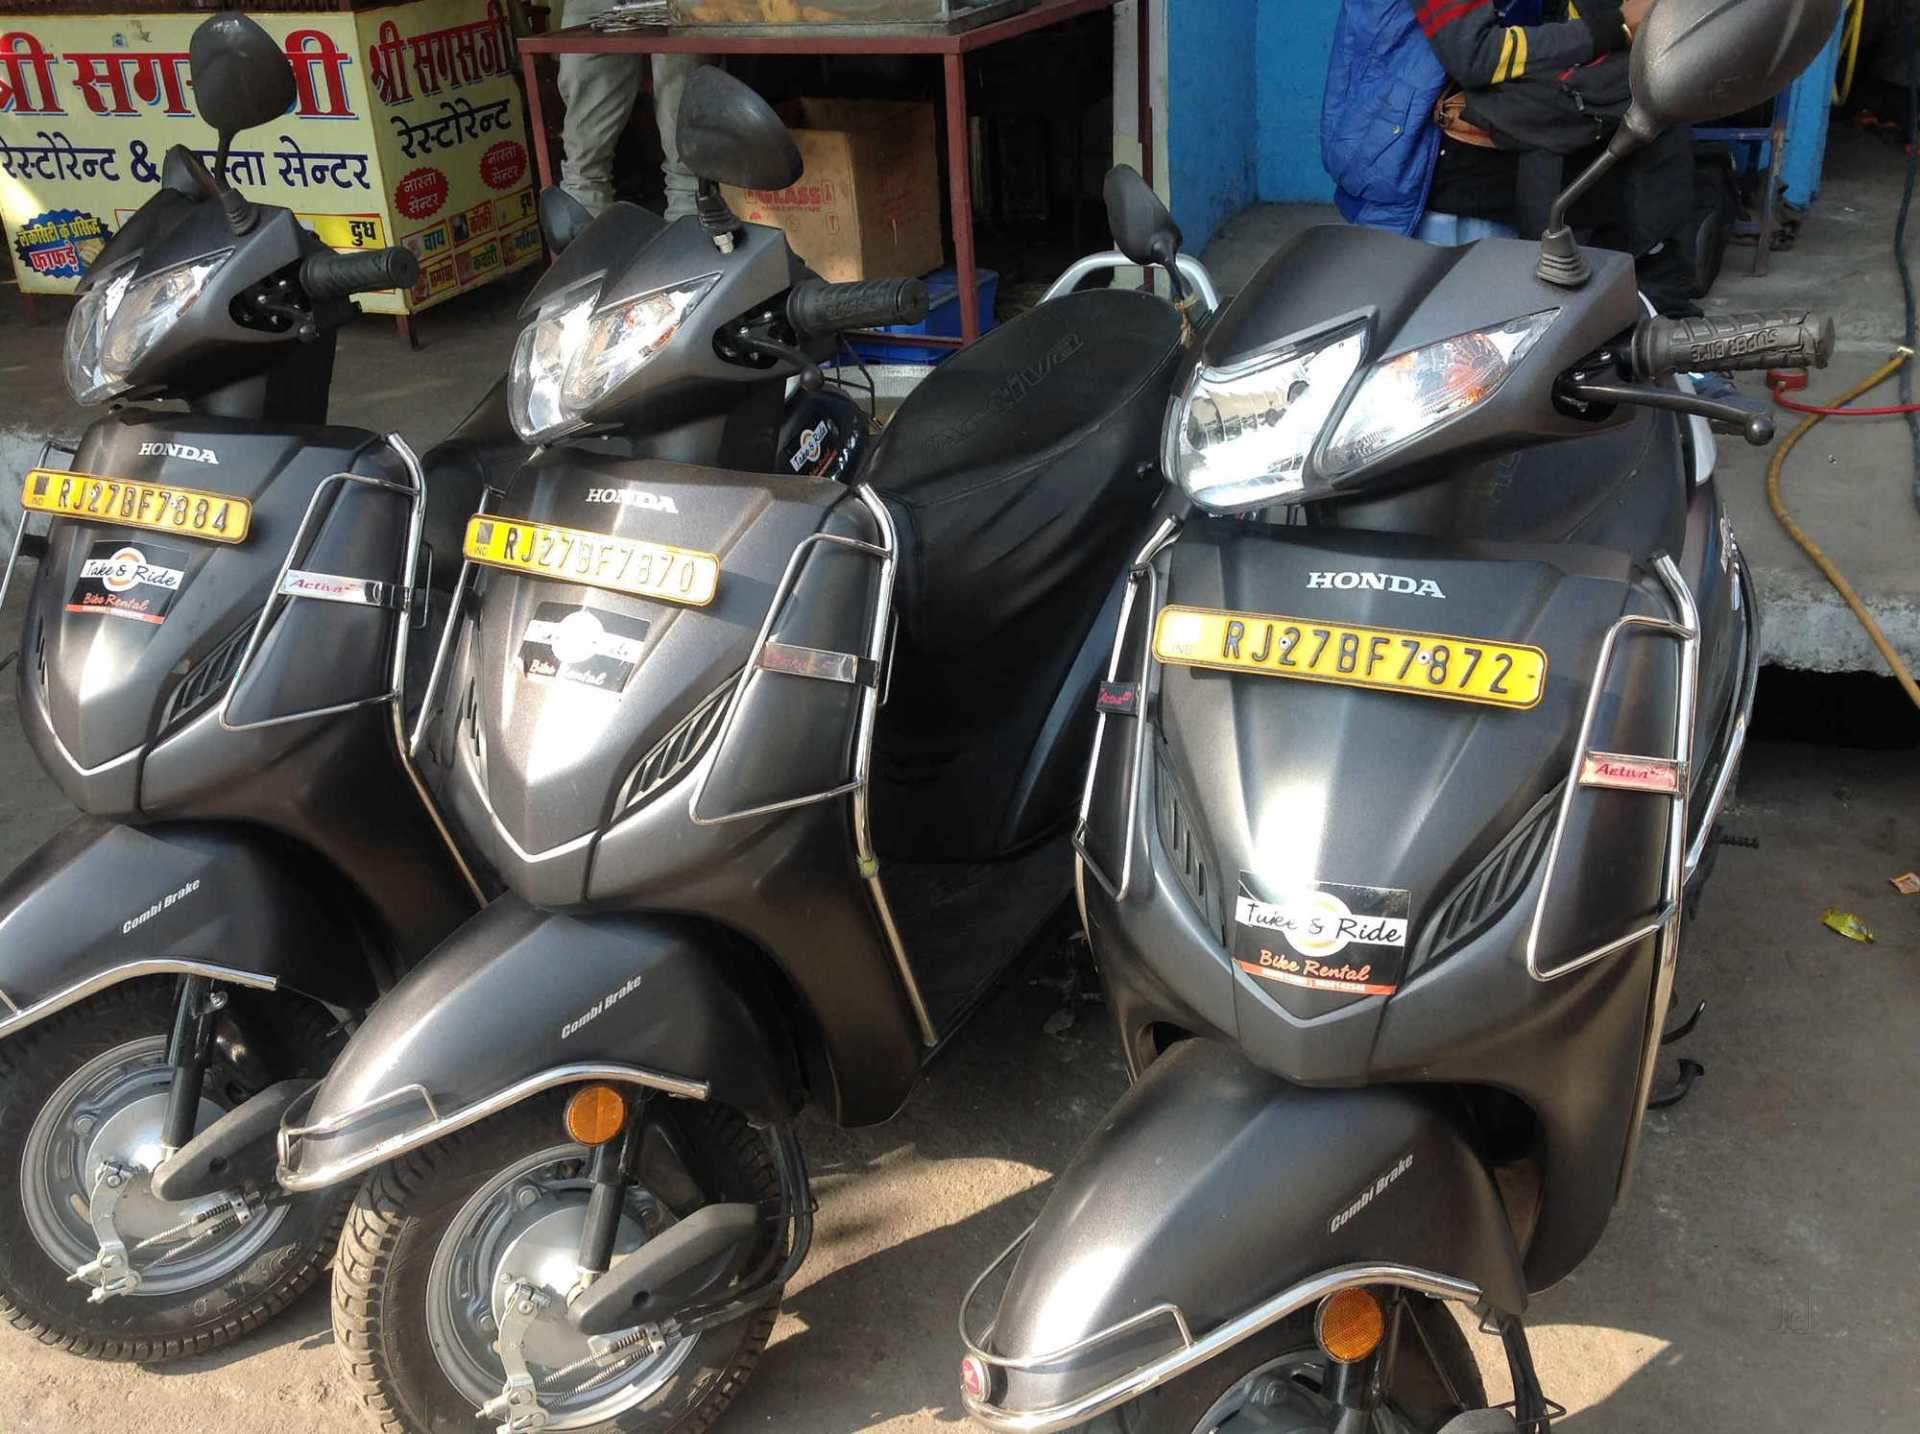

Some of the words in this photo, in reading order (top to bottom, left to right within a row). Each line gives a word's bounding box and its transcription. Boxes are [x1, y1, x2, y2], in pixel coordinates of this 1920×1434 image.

[391, 97, 512, 159] रेस्टोरेन्ट
[129, 140, 161, 183] &
[273, 135, 371, 190] सेन्टर
[138, 442, 220, 465] HONDA
[58, 477, 230, 533] RJ27BF7884
[585, 488, 680, 515] HONDA
[134, 565, 177, 587] Ride
[1306, 571, 1447, 599] HONDA
[1222, 618, 1516, 695] RJ27BF7872
[123, 900, 162, 934] Combi
[163, 879, 200, 909] Brake
[1336, 917, 1402, 943] Ride
[1259, 949, 1300, 972] Bike
[1303, 959, 1372, 982] Rental
[561, 1000, 603, 1040] Combi
[604, 975, 642, 1011] Brake
[1330, 1185, 1375, 1233] Combi
[1375, 1154, 1414, 1196] Brake
